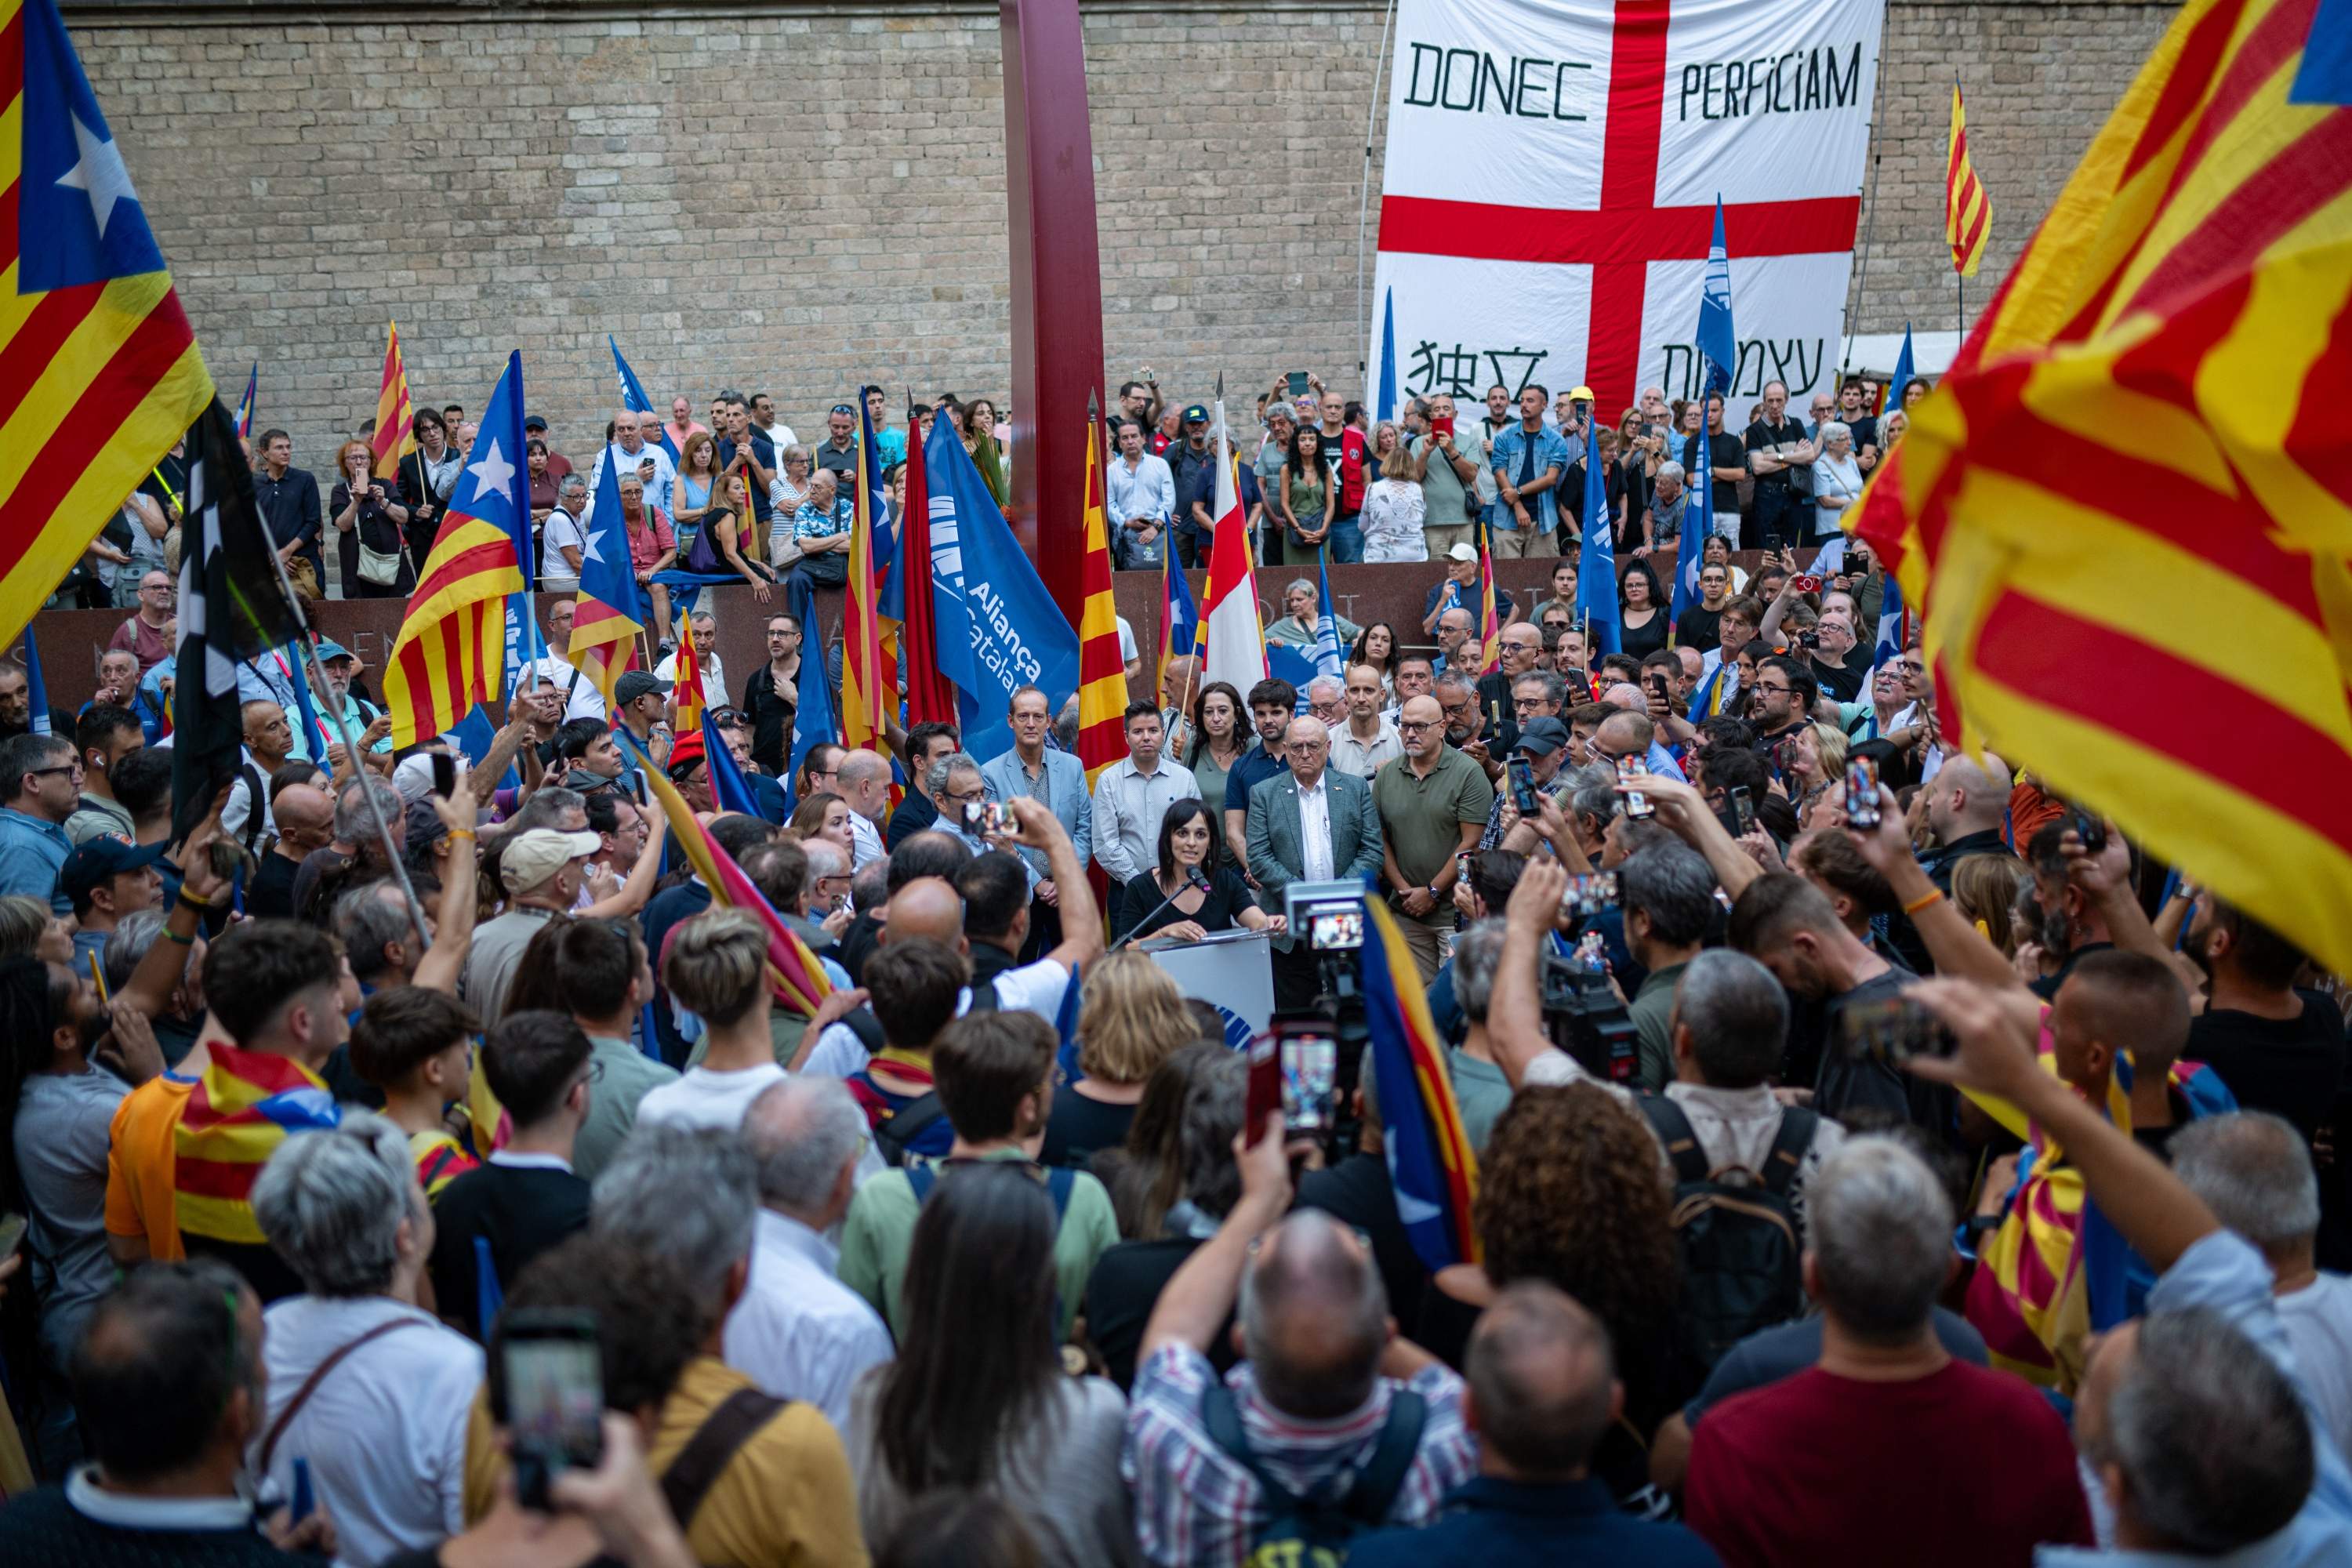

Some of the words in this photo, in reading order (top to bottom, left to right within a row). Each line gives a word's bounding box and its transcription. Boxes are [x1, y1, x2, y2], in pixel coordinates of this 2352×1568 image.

[1404, 42, 1592, 121] DONEC
[1662, 339, 1824, 401] עצמות
[968, 582, 1041, 684] Aliança
